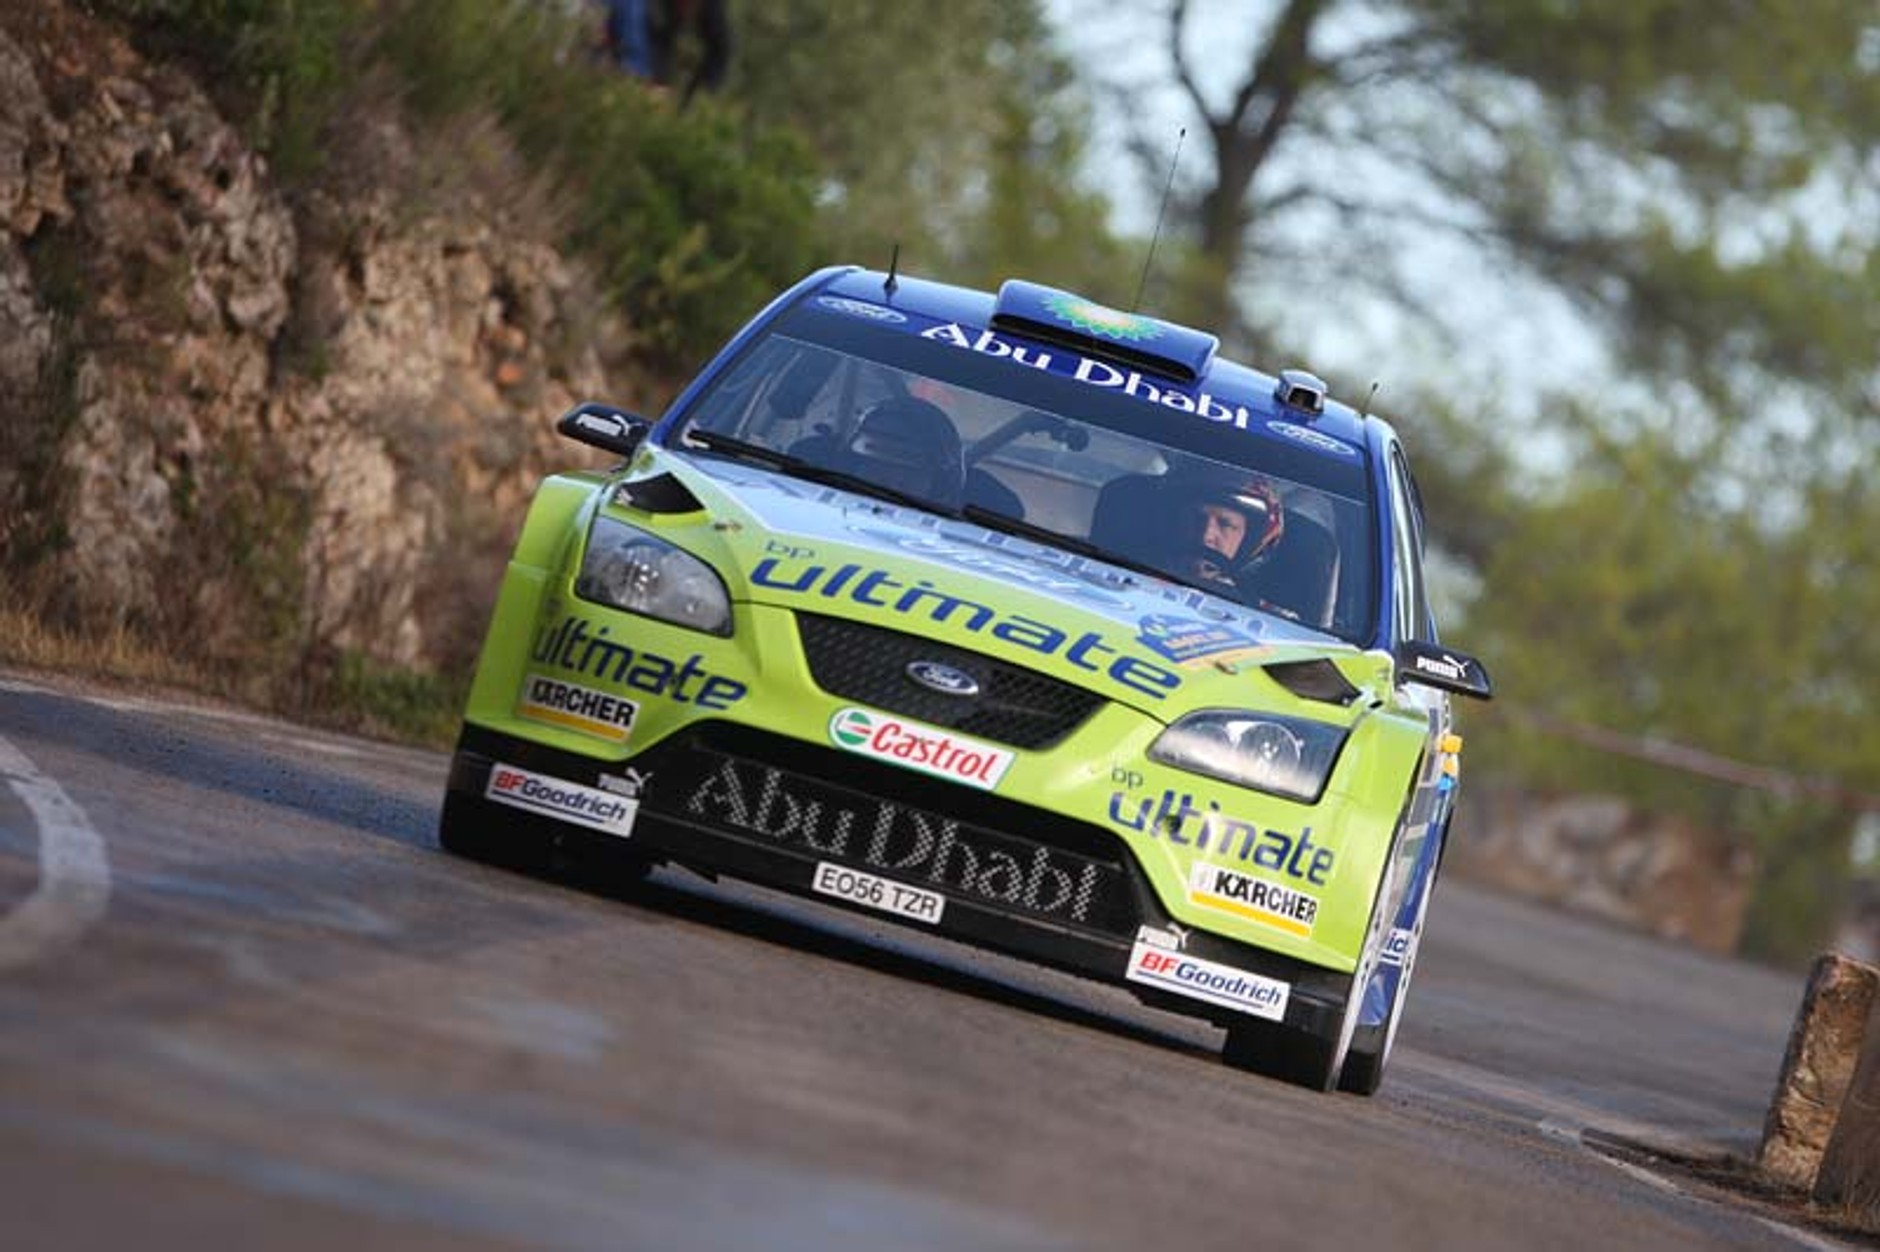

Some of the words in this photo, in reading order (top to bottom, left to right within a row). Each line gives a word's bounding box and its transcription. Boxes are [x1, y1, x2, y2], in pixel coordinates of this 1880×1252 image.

[920, 323, 1050, 370] Abu
[1073, 358, 1249, 429] Dhabi
[765, 540, 815, 560] bp
[750, 558, 1182, 699] ultimate
[532, 615, 747, 710] ultimate
[870, 722, 999, 783] Castrol
[494, 770, 627, 822] BFGoodrich
[686, 758, 855, 857] Abu
[865, 802, 1099, 922] Dhabi
[1109, 789, 1334, 886] ultimate
[892, 886, 938, 917] TZR
[1215, 870, 1317, 923] KÄRCHER
[1138, 950, 1282, 1006] BFGoodrich
